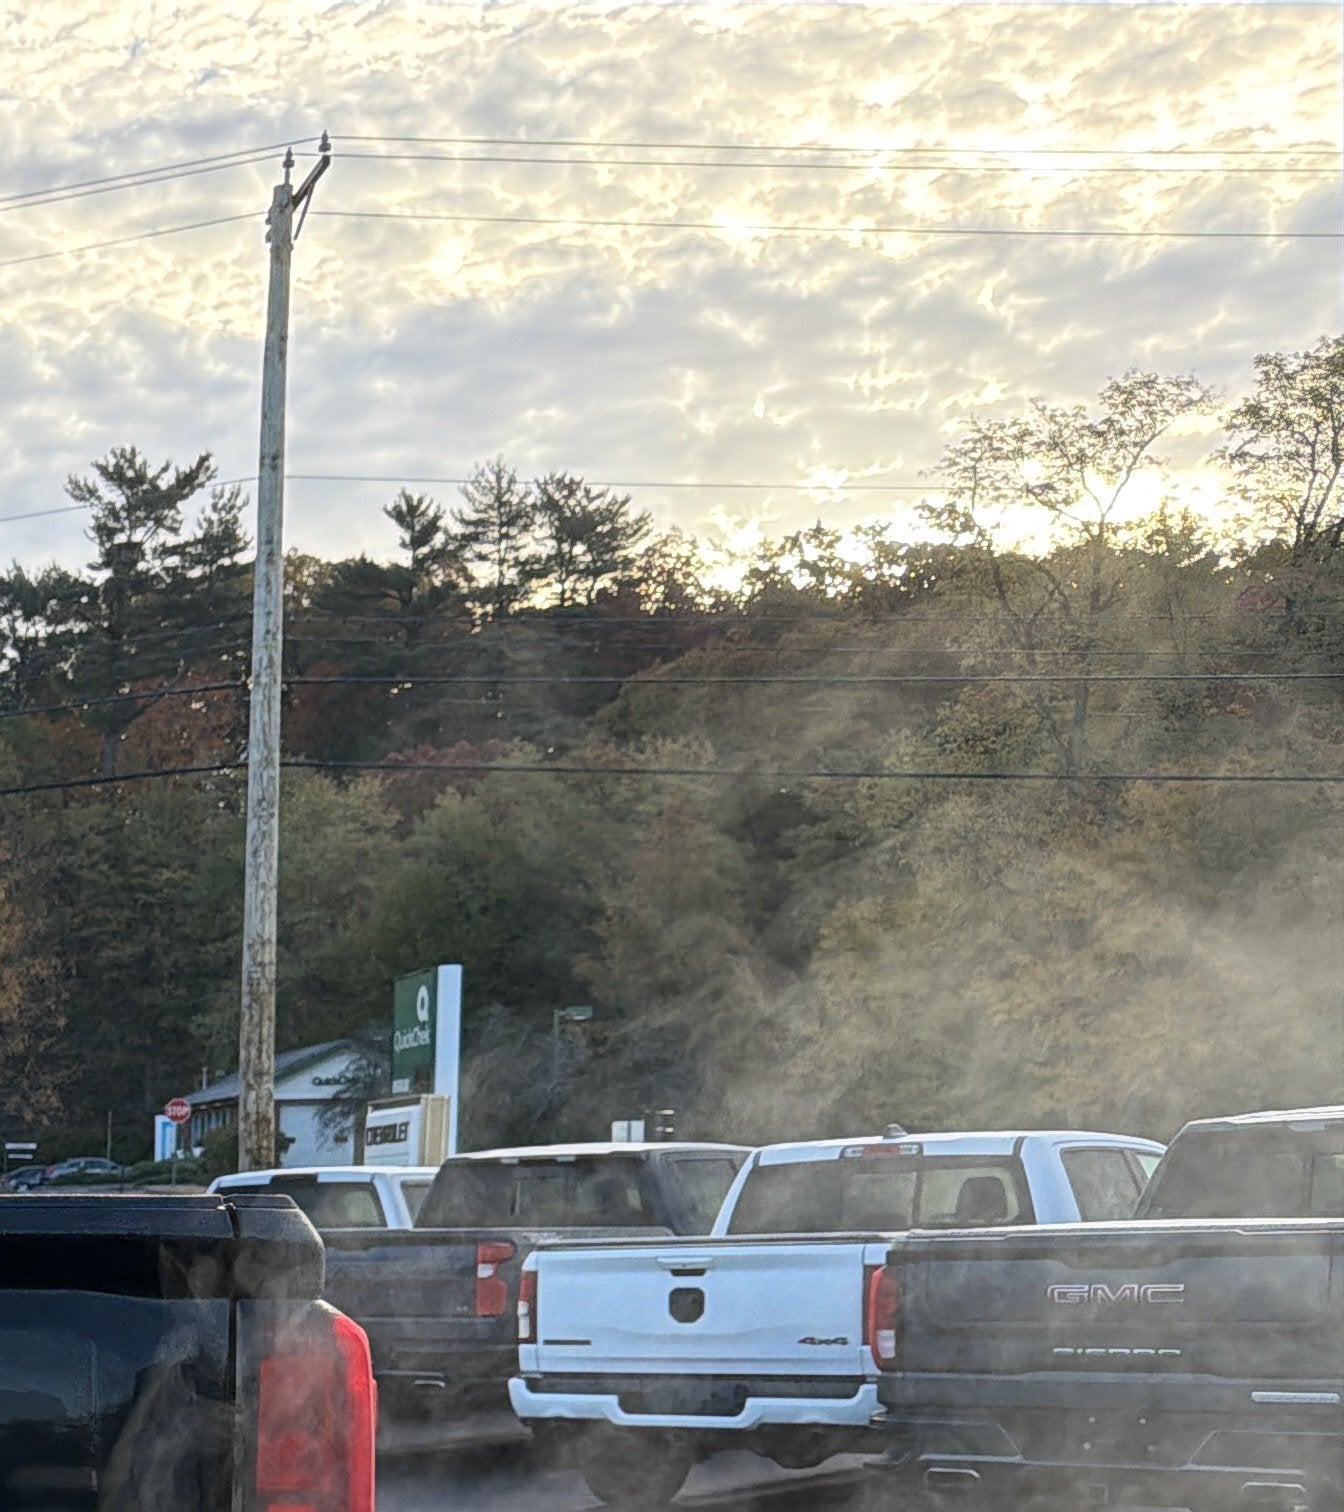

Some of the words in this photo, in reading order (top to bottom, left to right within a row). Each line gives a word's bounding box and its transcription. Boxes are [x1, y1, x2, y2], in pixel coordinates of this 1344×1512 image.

[393, 1025, 431, 1052] QuickChek
[166, 1105, 189, 1117] STOP
[1047, 1284, 1185, 1305] GMC
